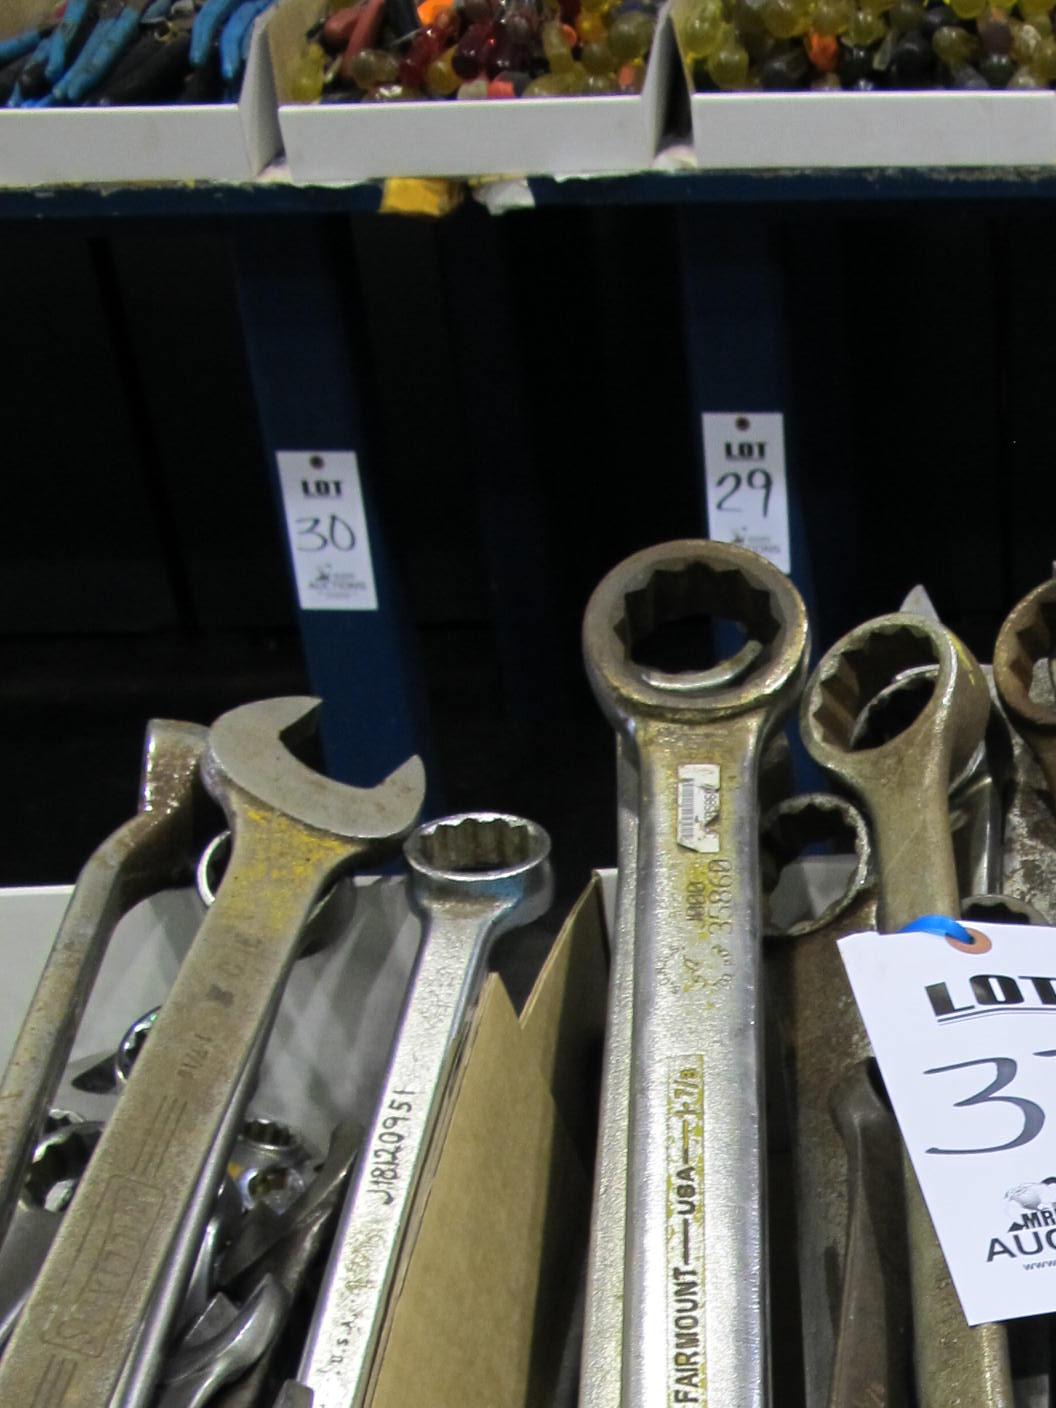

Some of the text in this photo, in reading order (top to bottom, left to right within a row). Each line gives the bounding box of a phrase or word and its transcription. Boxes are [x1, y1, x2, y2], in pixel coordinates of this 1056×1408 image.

[724, 441, 767, 459] LOT
[301, 479, 343, 497] LOT
[716, 468, 773, 518] 29
[295, 513, 356, 552] 30
[676, 1165, 697, 1216] USA
[674, 1266, 701, 1405] FAIRMOUNT
